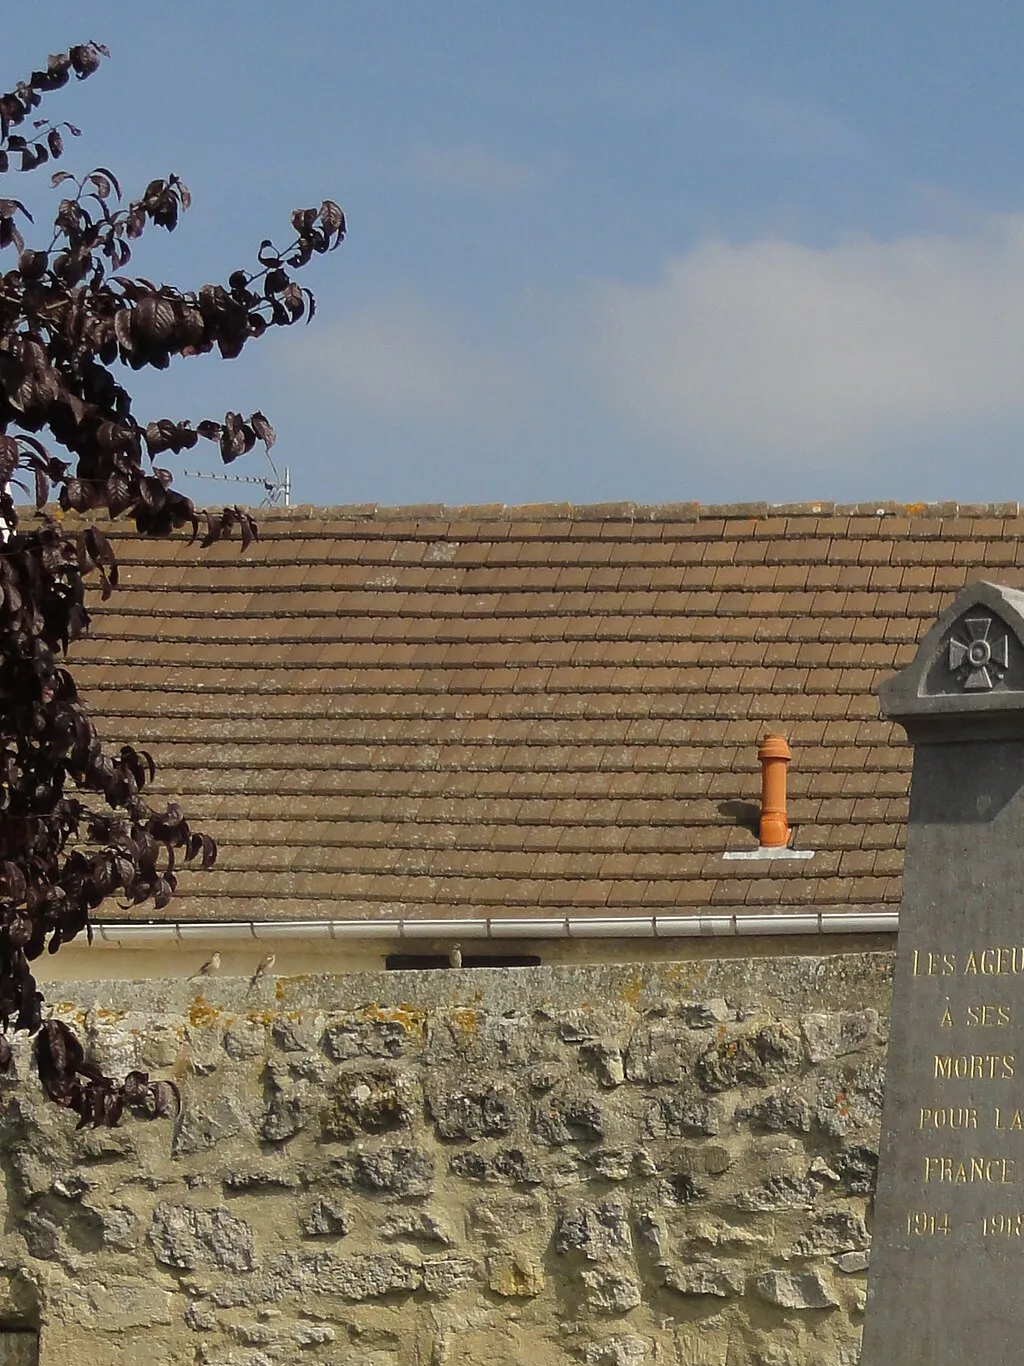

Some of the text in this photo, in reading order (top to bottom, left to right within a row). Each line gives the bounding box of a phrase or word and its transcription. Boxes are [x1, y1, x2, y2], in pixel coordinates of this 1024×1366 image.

[913, 949, 956, 977] LES
[940, 996, 1011, 1027] À SES
[933, 1054, 1016, 1079] MORTS
[918, 1107, 1024, 1131] POUR LA
[924, 1156, 1017, 1185] FRANCE
[906, 1210, 952, 1236] 1914
